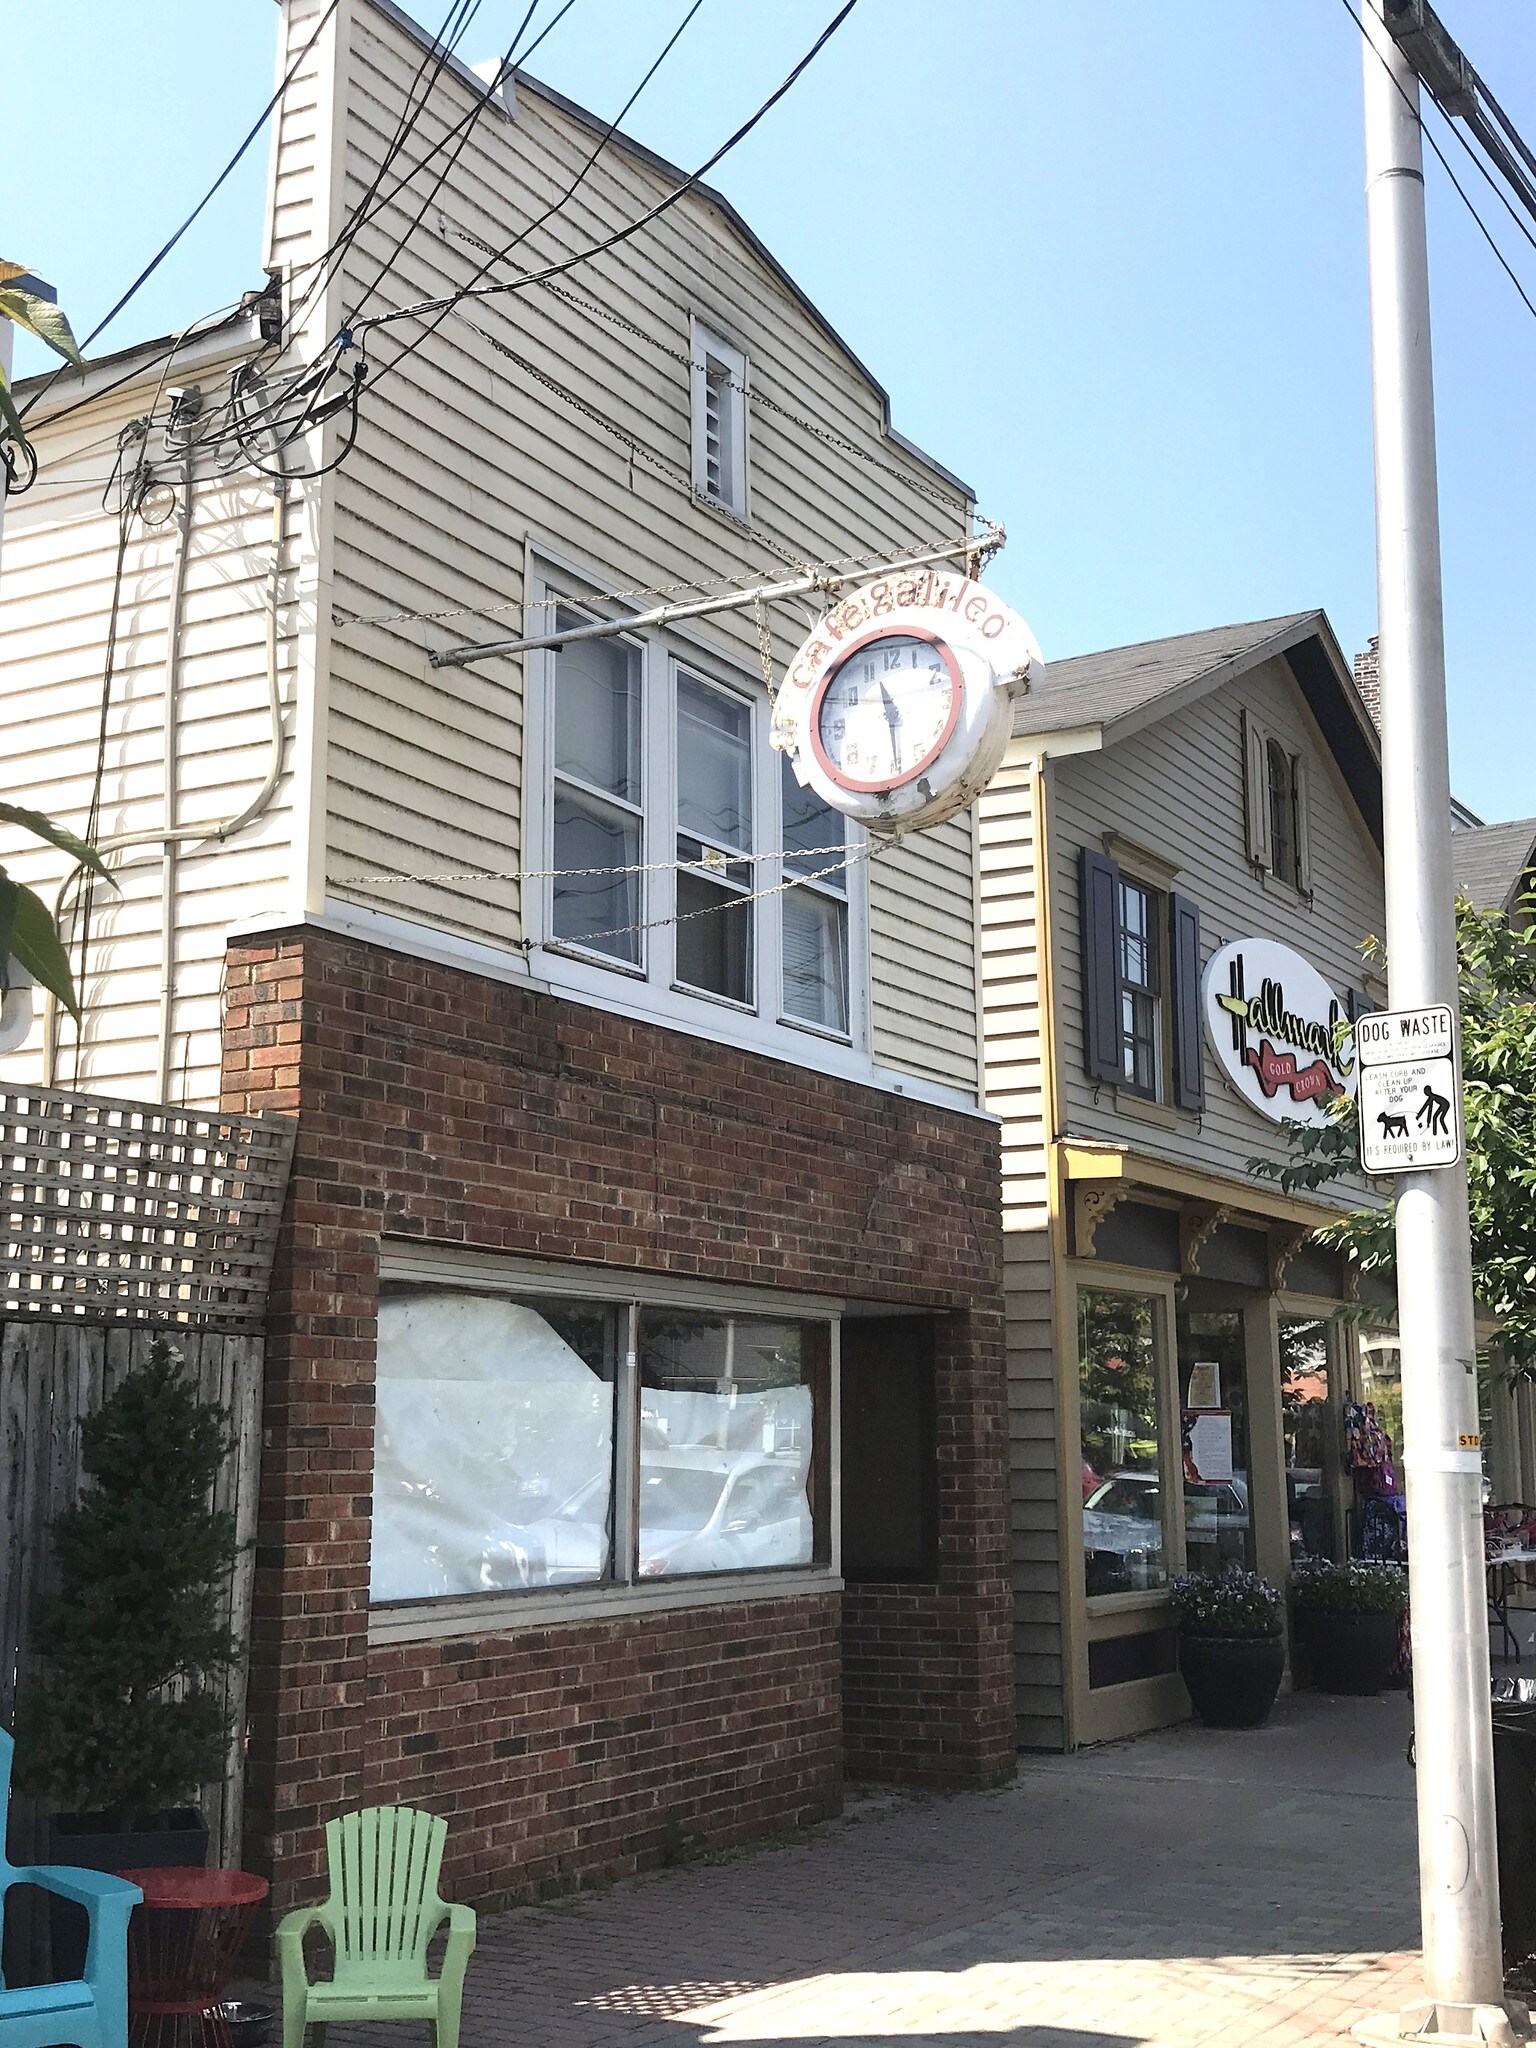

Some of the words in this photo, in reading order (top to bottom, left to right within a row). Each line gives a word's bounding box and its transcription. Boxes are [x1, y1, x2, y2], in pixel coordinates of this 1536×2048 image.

[1215, 954, 1356, 1076] Hallmark
[1362, 1022, 1389, 1042] DOG
[1400, 1014, 1447, 1037] WASTE
[1269, 1062, 1291, 1076] GOLD
[1411, 1067, 1426, 1075] AND
[1378, 1078, 1400, 1087] CLEAN
[1375, 1087, 1397, 1096] AFTER
[1400, 1085, 1417, 1093] YOUR
[1389, 1095, 1403, 1103] DOG
[1366, 1146, 1379, 1156] ITS
[1383, 1142, 1418, 1154] REQUIRED
[1422, 1141, 1431, 1151] BY
